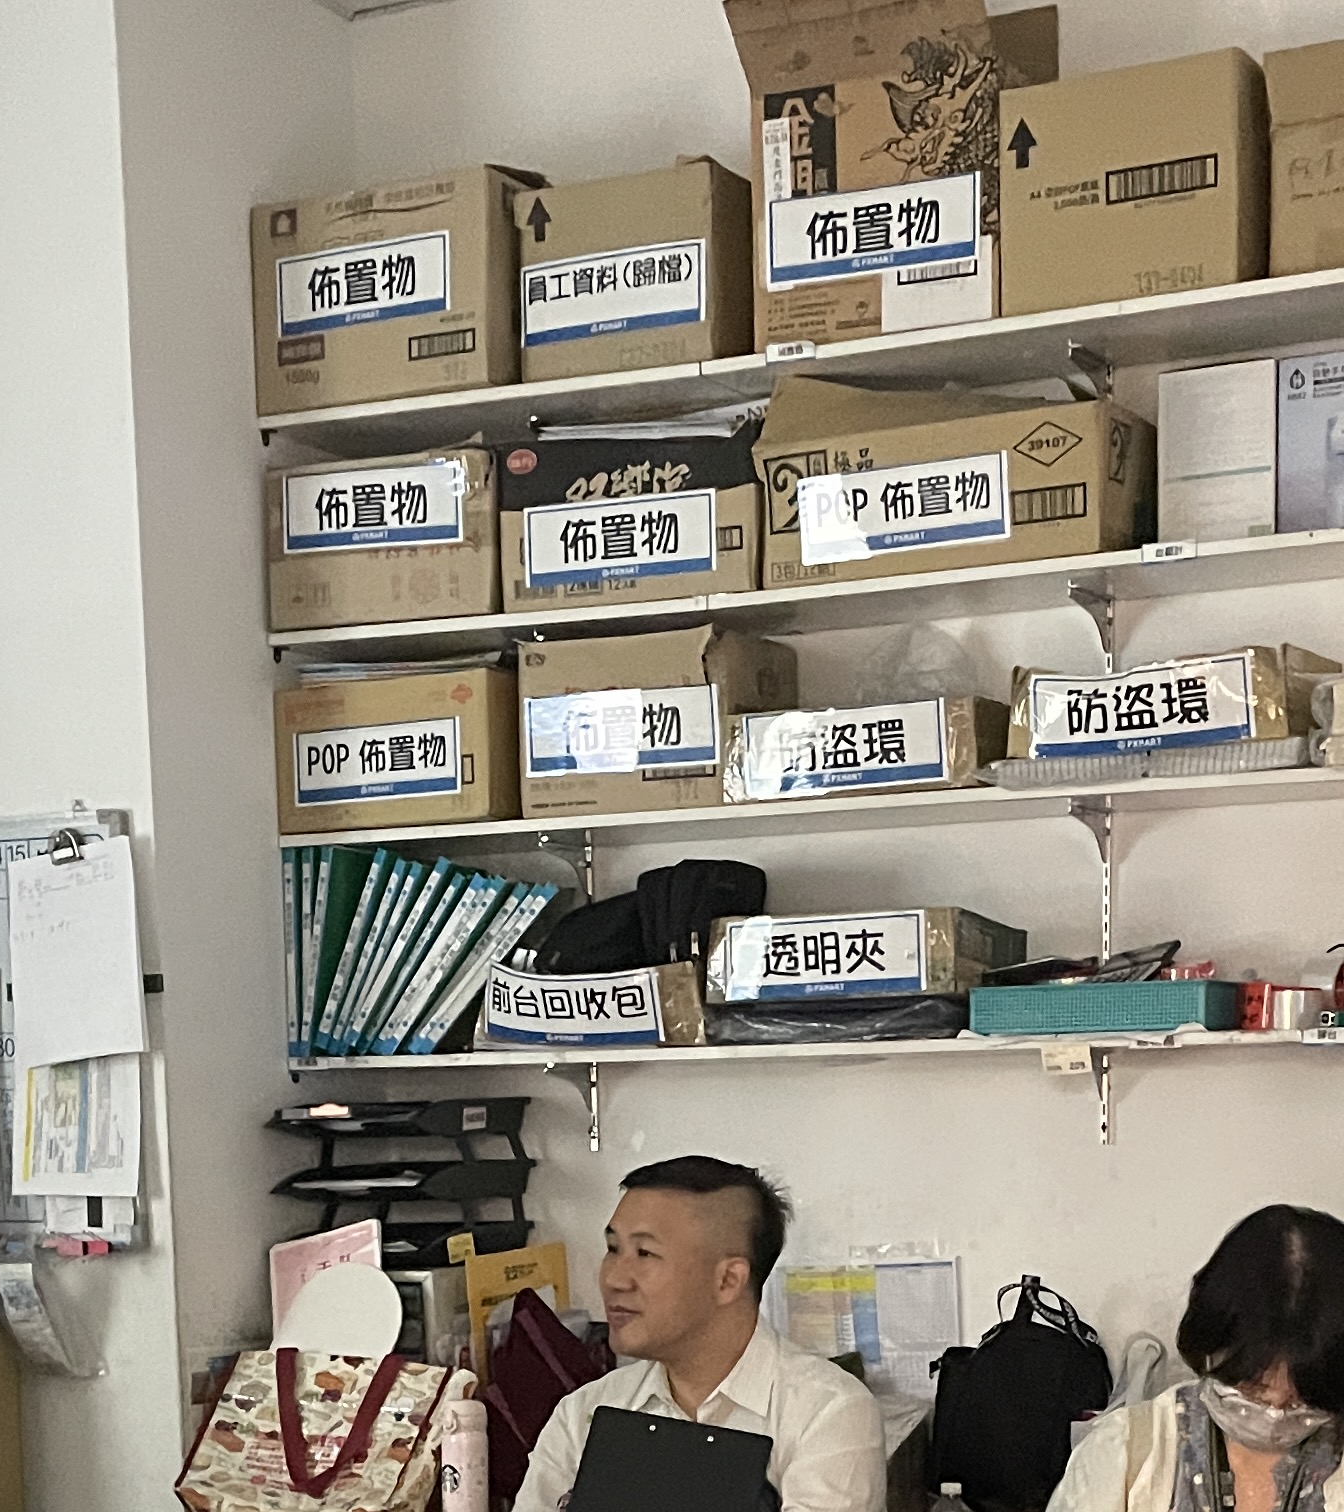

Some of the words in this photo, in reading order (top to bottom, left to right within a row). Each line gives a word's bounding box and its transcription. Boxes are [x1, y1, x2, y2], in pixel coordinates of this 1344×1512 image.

[806, 197, 939, 260] 佈置物
[308, 253, 416, 312] 佈置物
[315, 481, 428, 531] 佈置物
[880, 470, 991, 522] 佈置物
[560, 510, 679, 564] 佈置物
[1067, 676, 1209, 735] 防盜環
[307, 743, 350, 776] POP
[359, 732, 447, 775] 佈置物
[1127, 737, 1161, 748] PXMART
[763, 929, 886, 977] 透明夾
[492, 977, 648, 1020] 前台回收包
